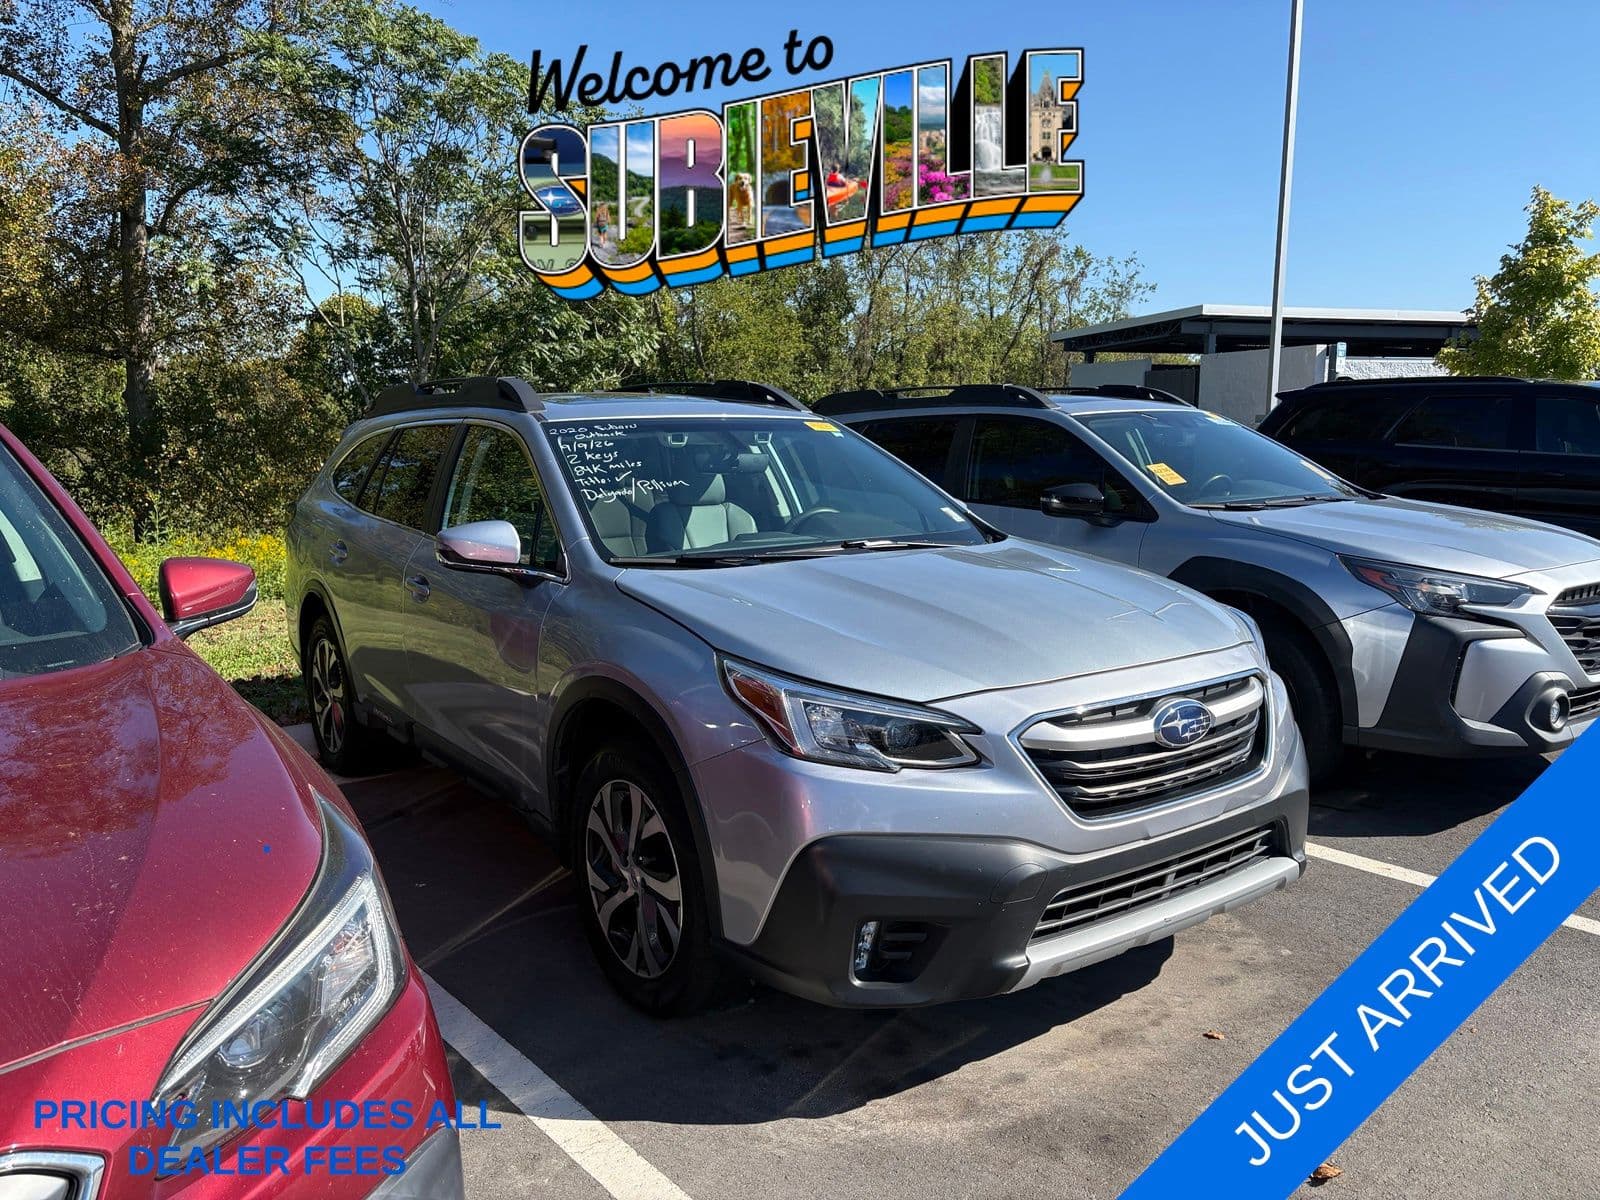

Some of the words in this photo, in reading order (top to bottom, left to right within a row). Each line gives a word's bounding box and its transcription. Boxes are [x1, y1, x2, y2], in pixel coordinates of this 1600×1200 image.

[549, 427, 588, 435] 2020
[594, 423, 637, 431] Subaru
[574, 430, 627, 440] Outback
[567, 454, 581, 465] 2
[609, 459, 642, 470] miles
